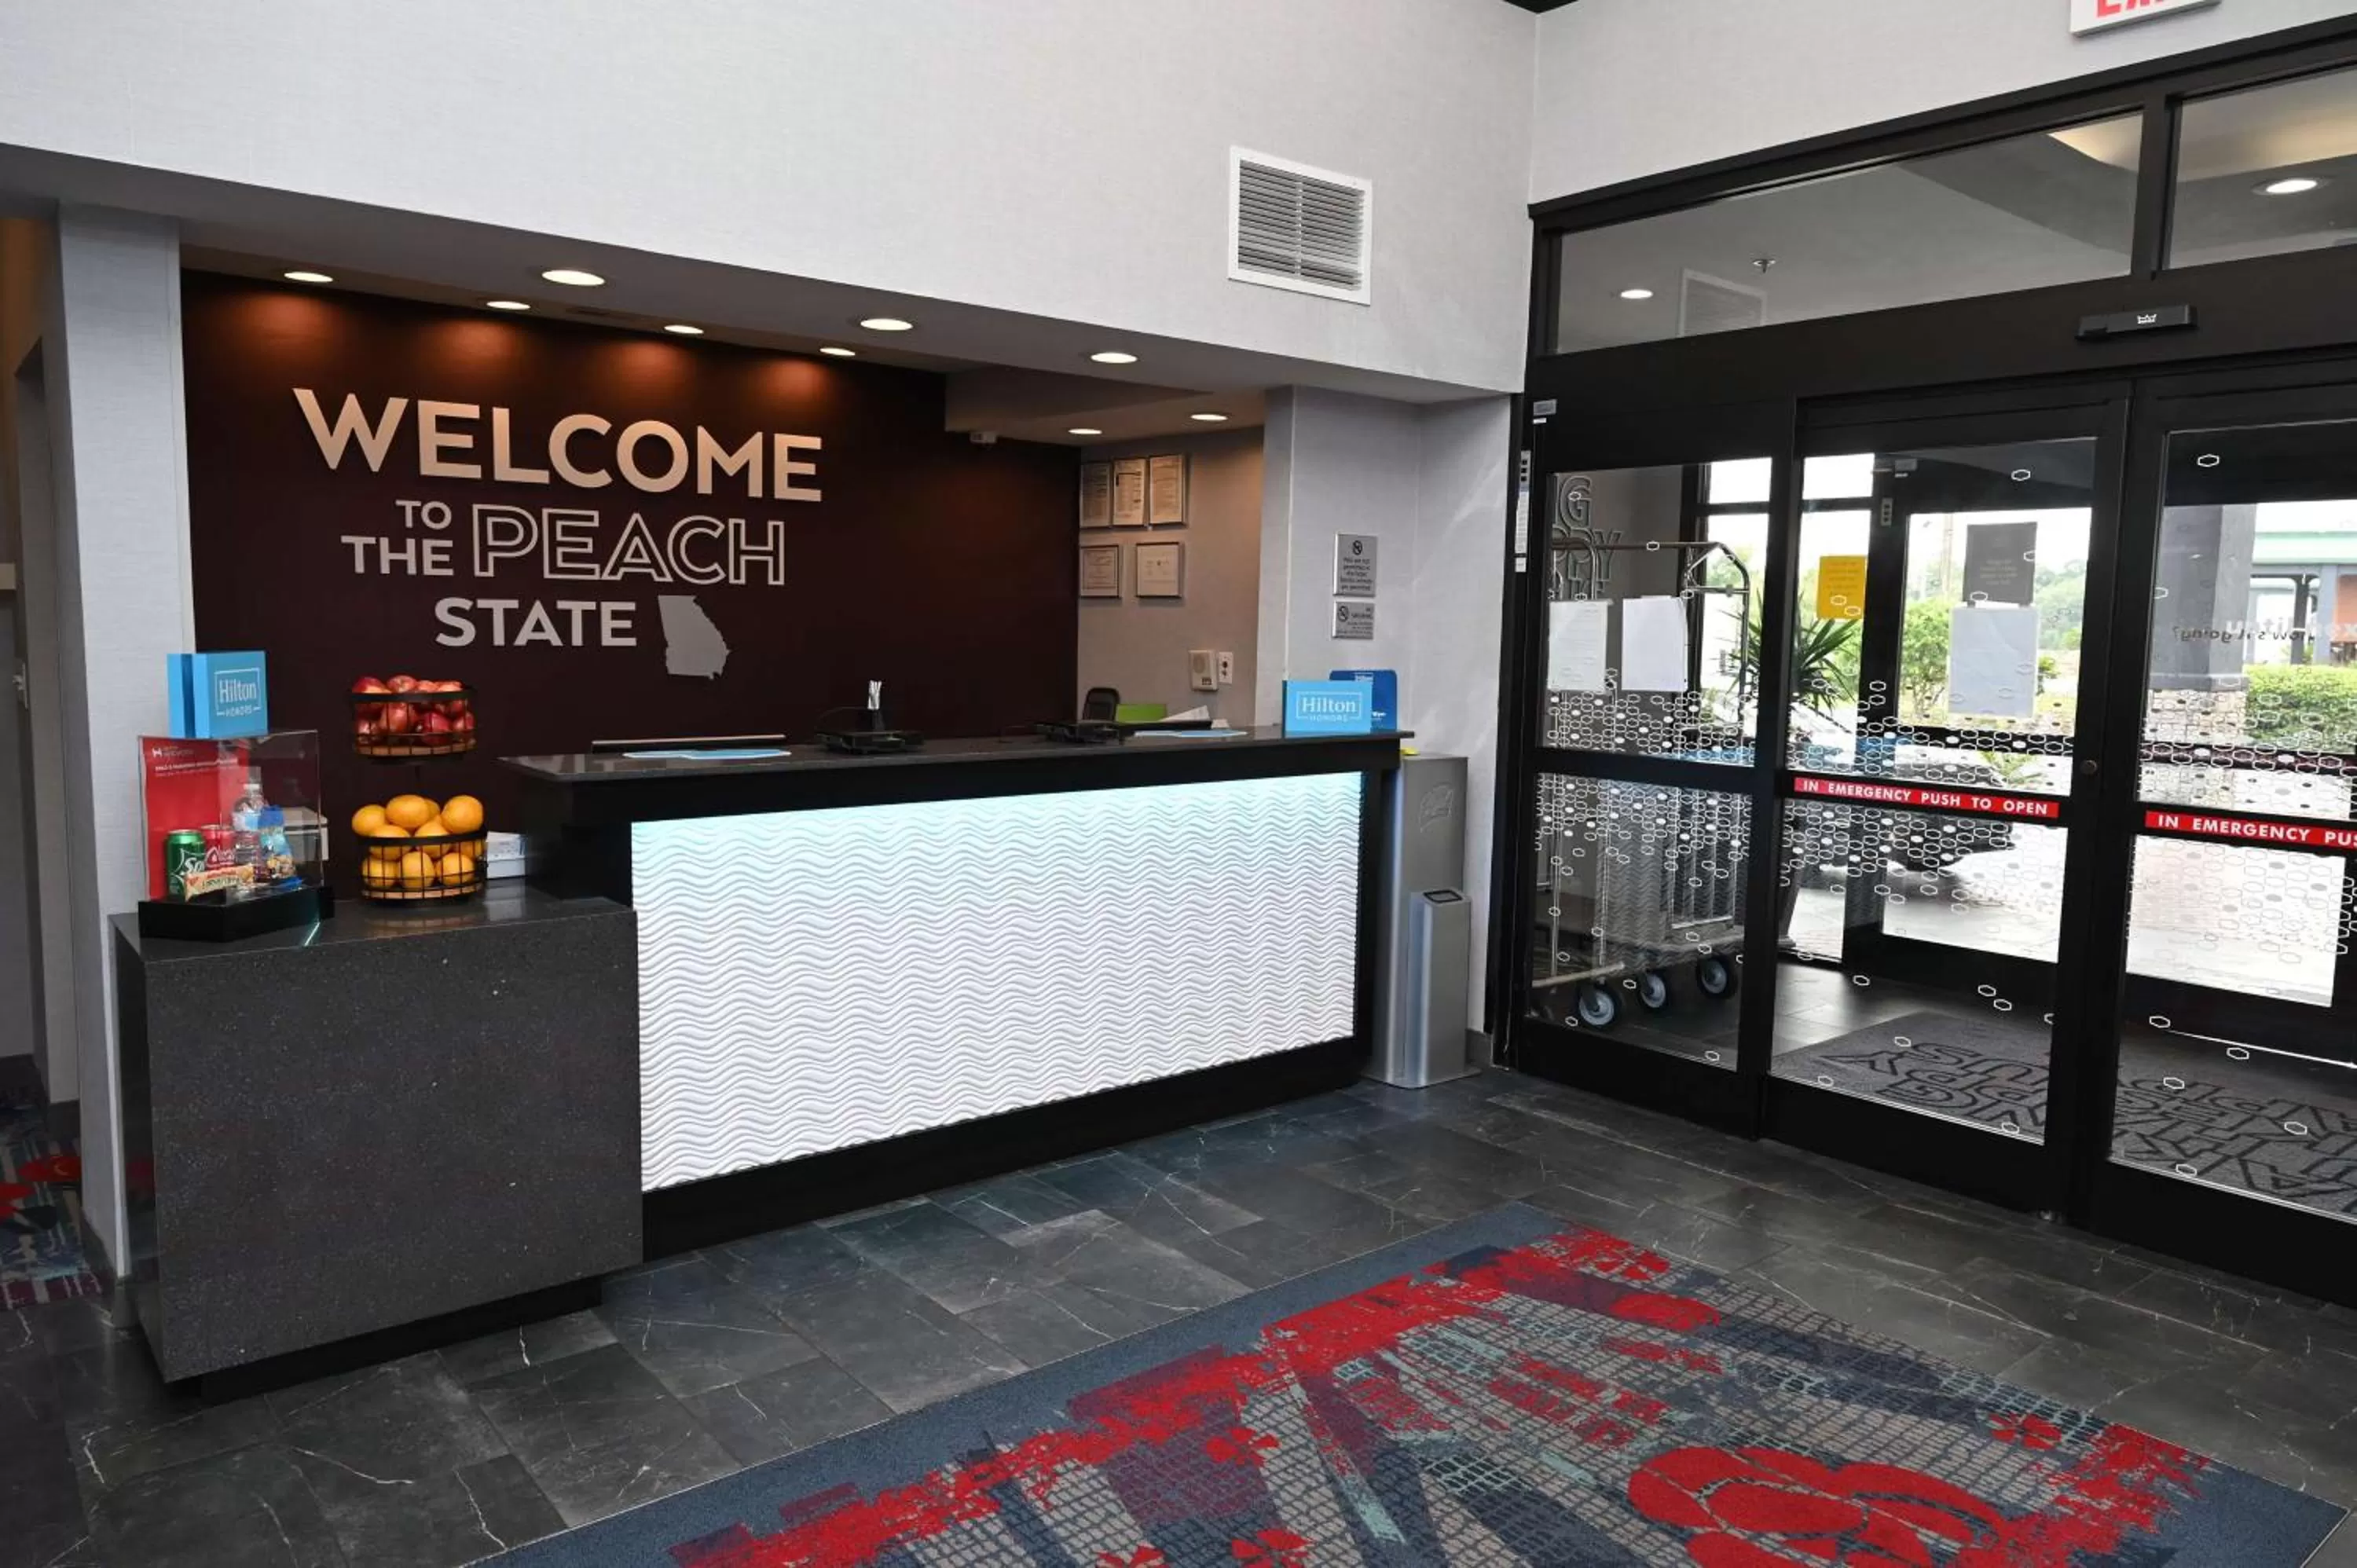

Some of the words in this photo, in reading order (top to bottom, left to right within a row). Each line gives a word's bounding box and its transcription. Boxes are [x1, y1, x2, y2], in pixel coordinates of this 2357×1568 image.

[292, 387, 822, 502] WELCOME
[395, 499, 452, 529] TO
[341, 535, 454, 577] THE
[472, 504, 785, 586] PEACH
[434, 597, 637, 647] STATE
[218, 678, 257, 705] Hilton
[1302, 696, 1358, 713] Hilton
[1803, 780, 1819, 791] IN
[1827, 782, 1912, 801] EMERGENCY
[1921, 793, 1961, 807] PUSH
[1971, 797, 1992, 810] TO
[2003, 800, 2047, 815] OPEN
[2158, 815, 2179, 829] IN
[2193, 818, 2311, 841] EMERGENCY
